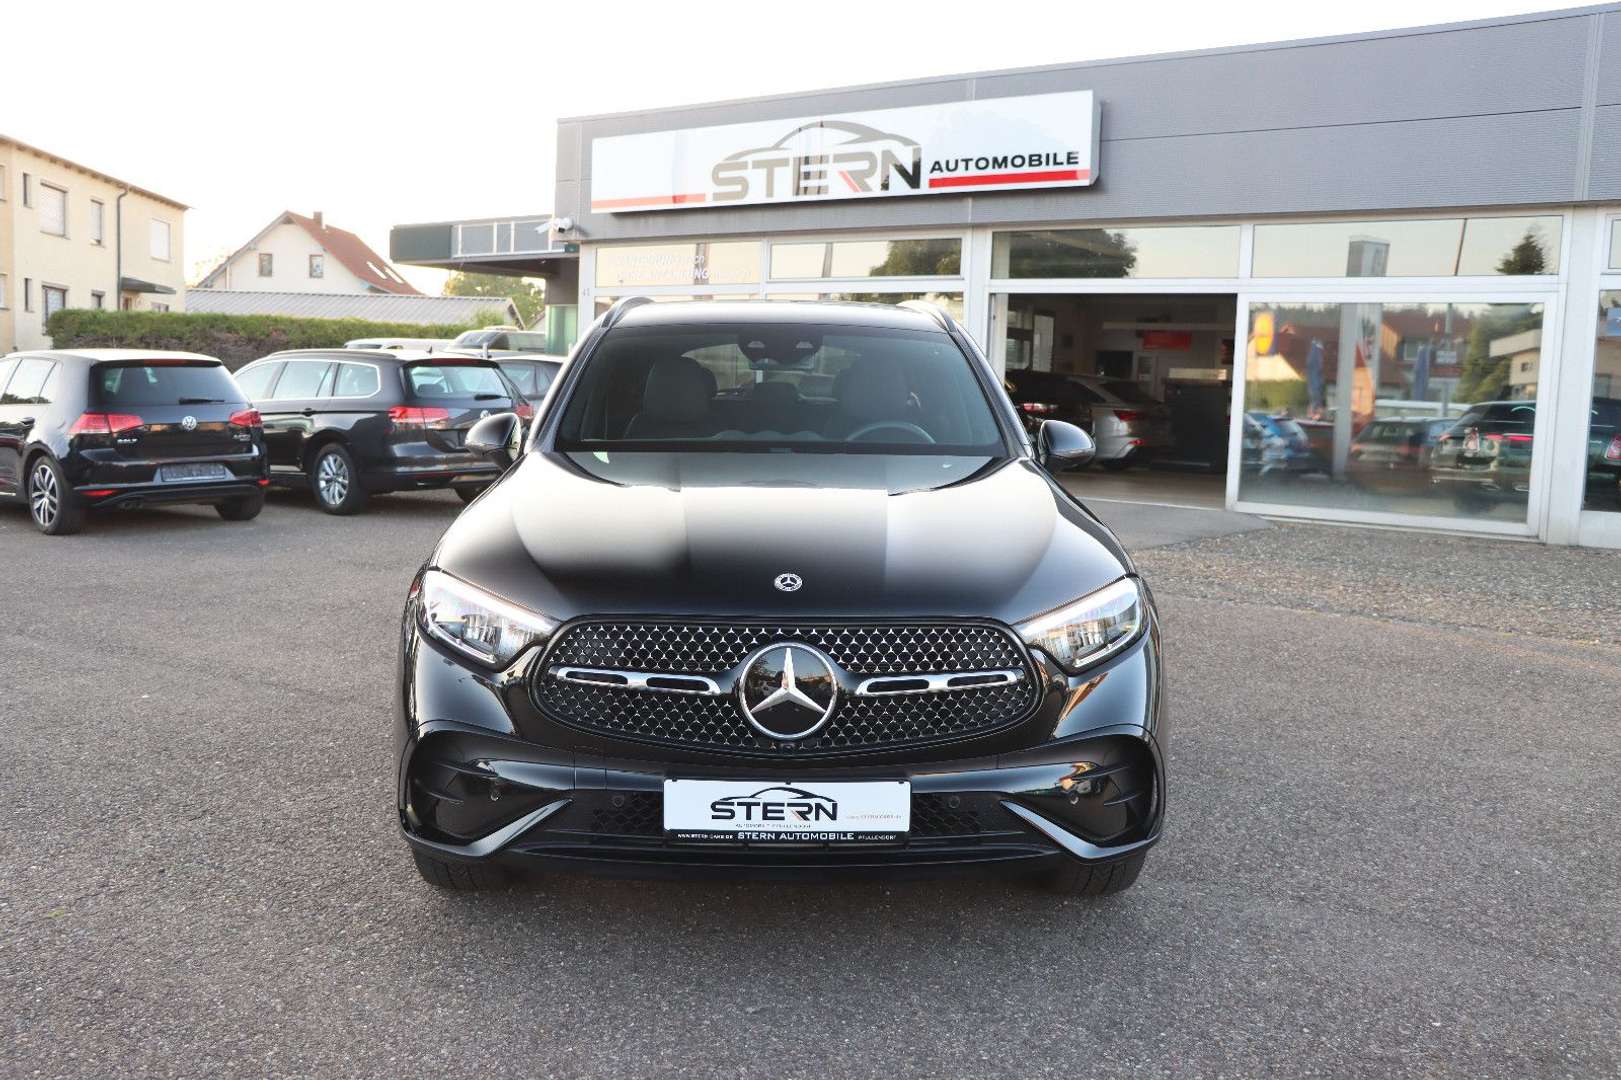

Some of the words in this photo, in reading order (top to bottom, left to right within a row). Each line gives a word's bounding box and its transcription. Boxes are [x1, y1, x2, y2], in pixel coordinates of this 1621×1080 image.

[713, 145, 921, 201] STERN
[930, 152, 1079, 174] AUTOMOBILE
[711, 801, 838, 821] STERN
[738, 831, 776, 841] STERN
[779, 832, 855, 842] AUTOMOBILE
